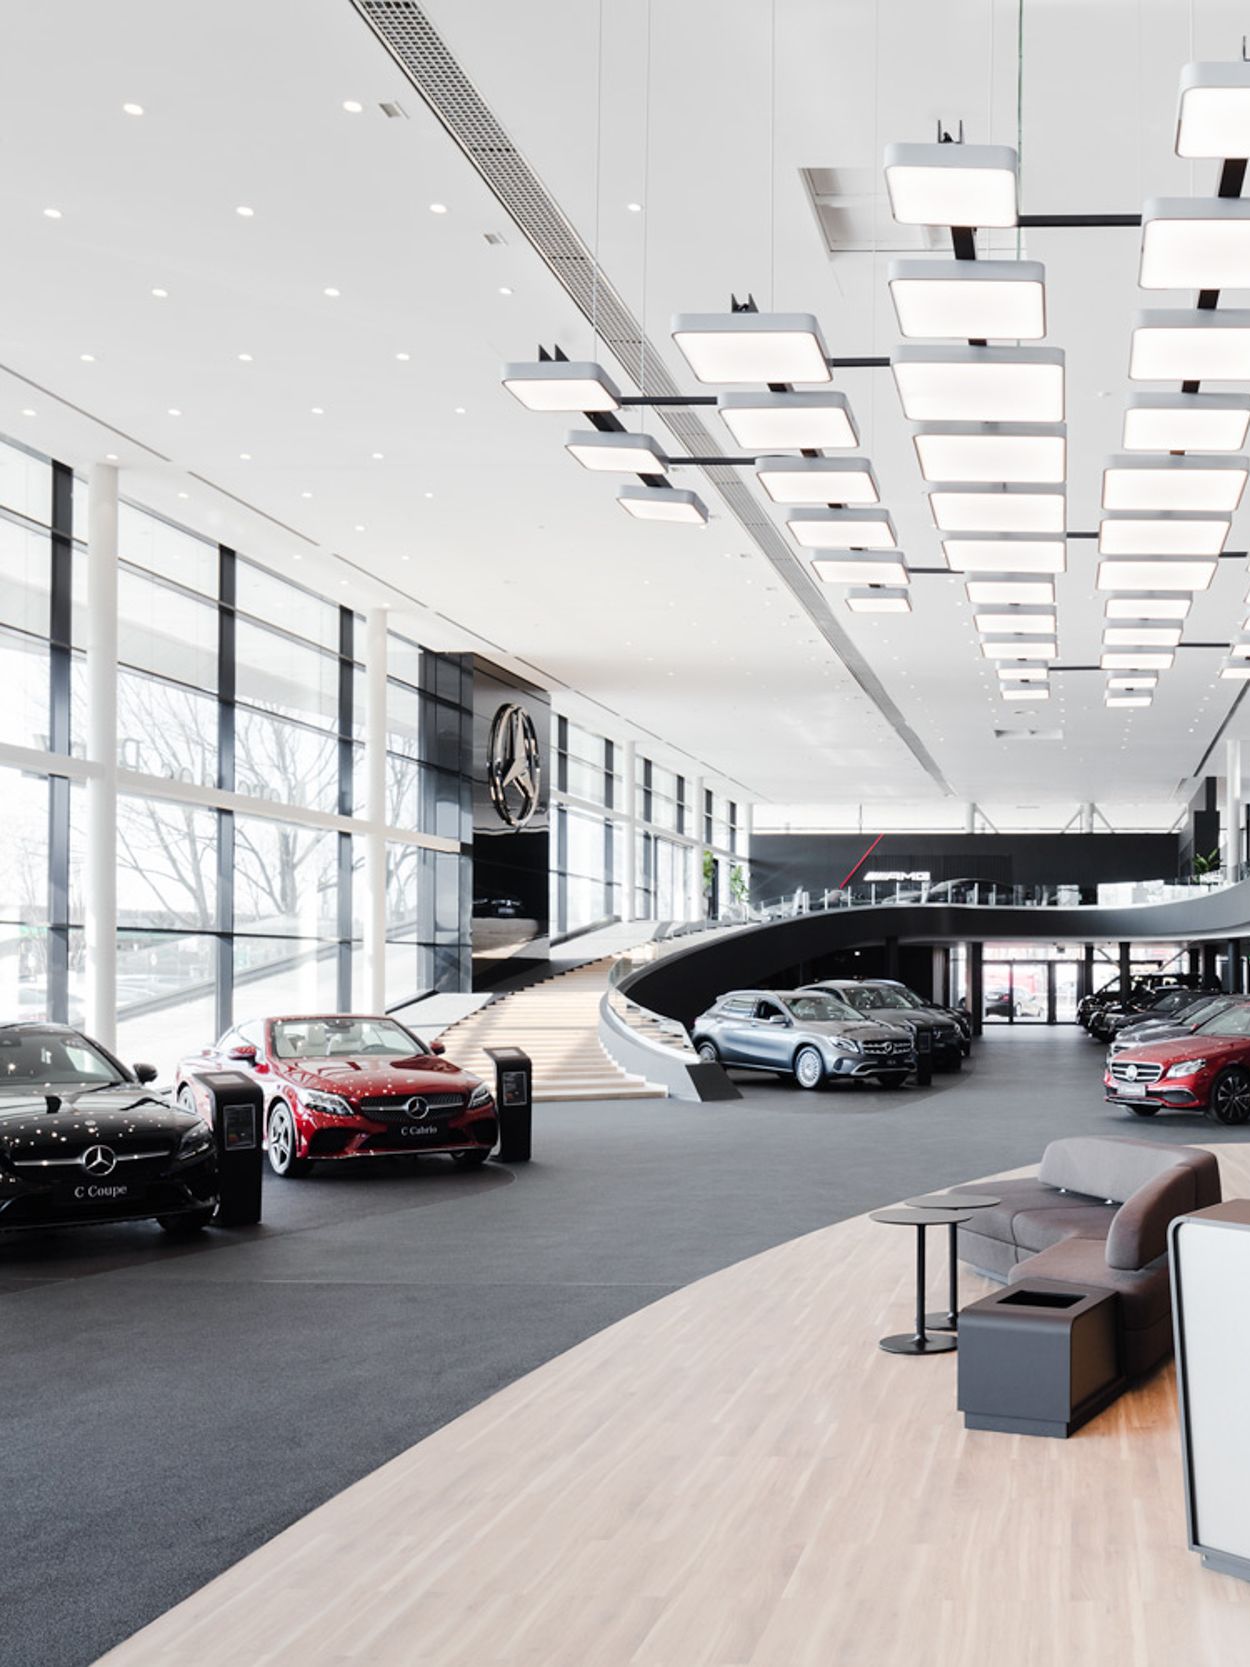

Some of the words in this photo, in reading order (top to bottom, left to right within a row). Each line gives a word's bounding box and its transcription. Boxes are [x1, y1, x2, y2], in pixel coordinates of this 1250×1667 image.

[886, 871, 931, 881] AMG
[401, 1126, 408, 1136] C
[74, 1186, 85, 1198] C
